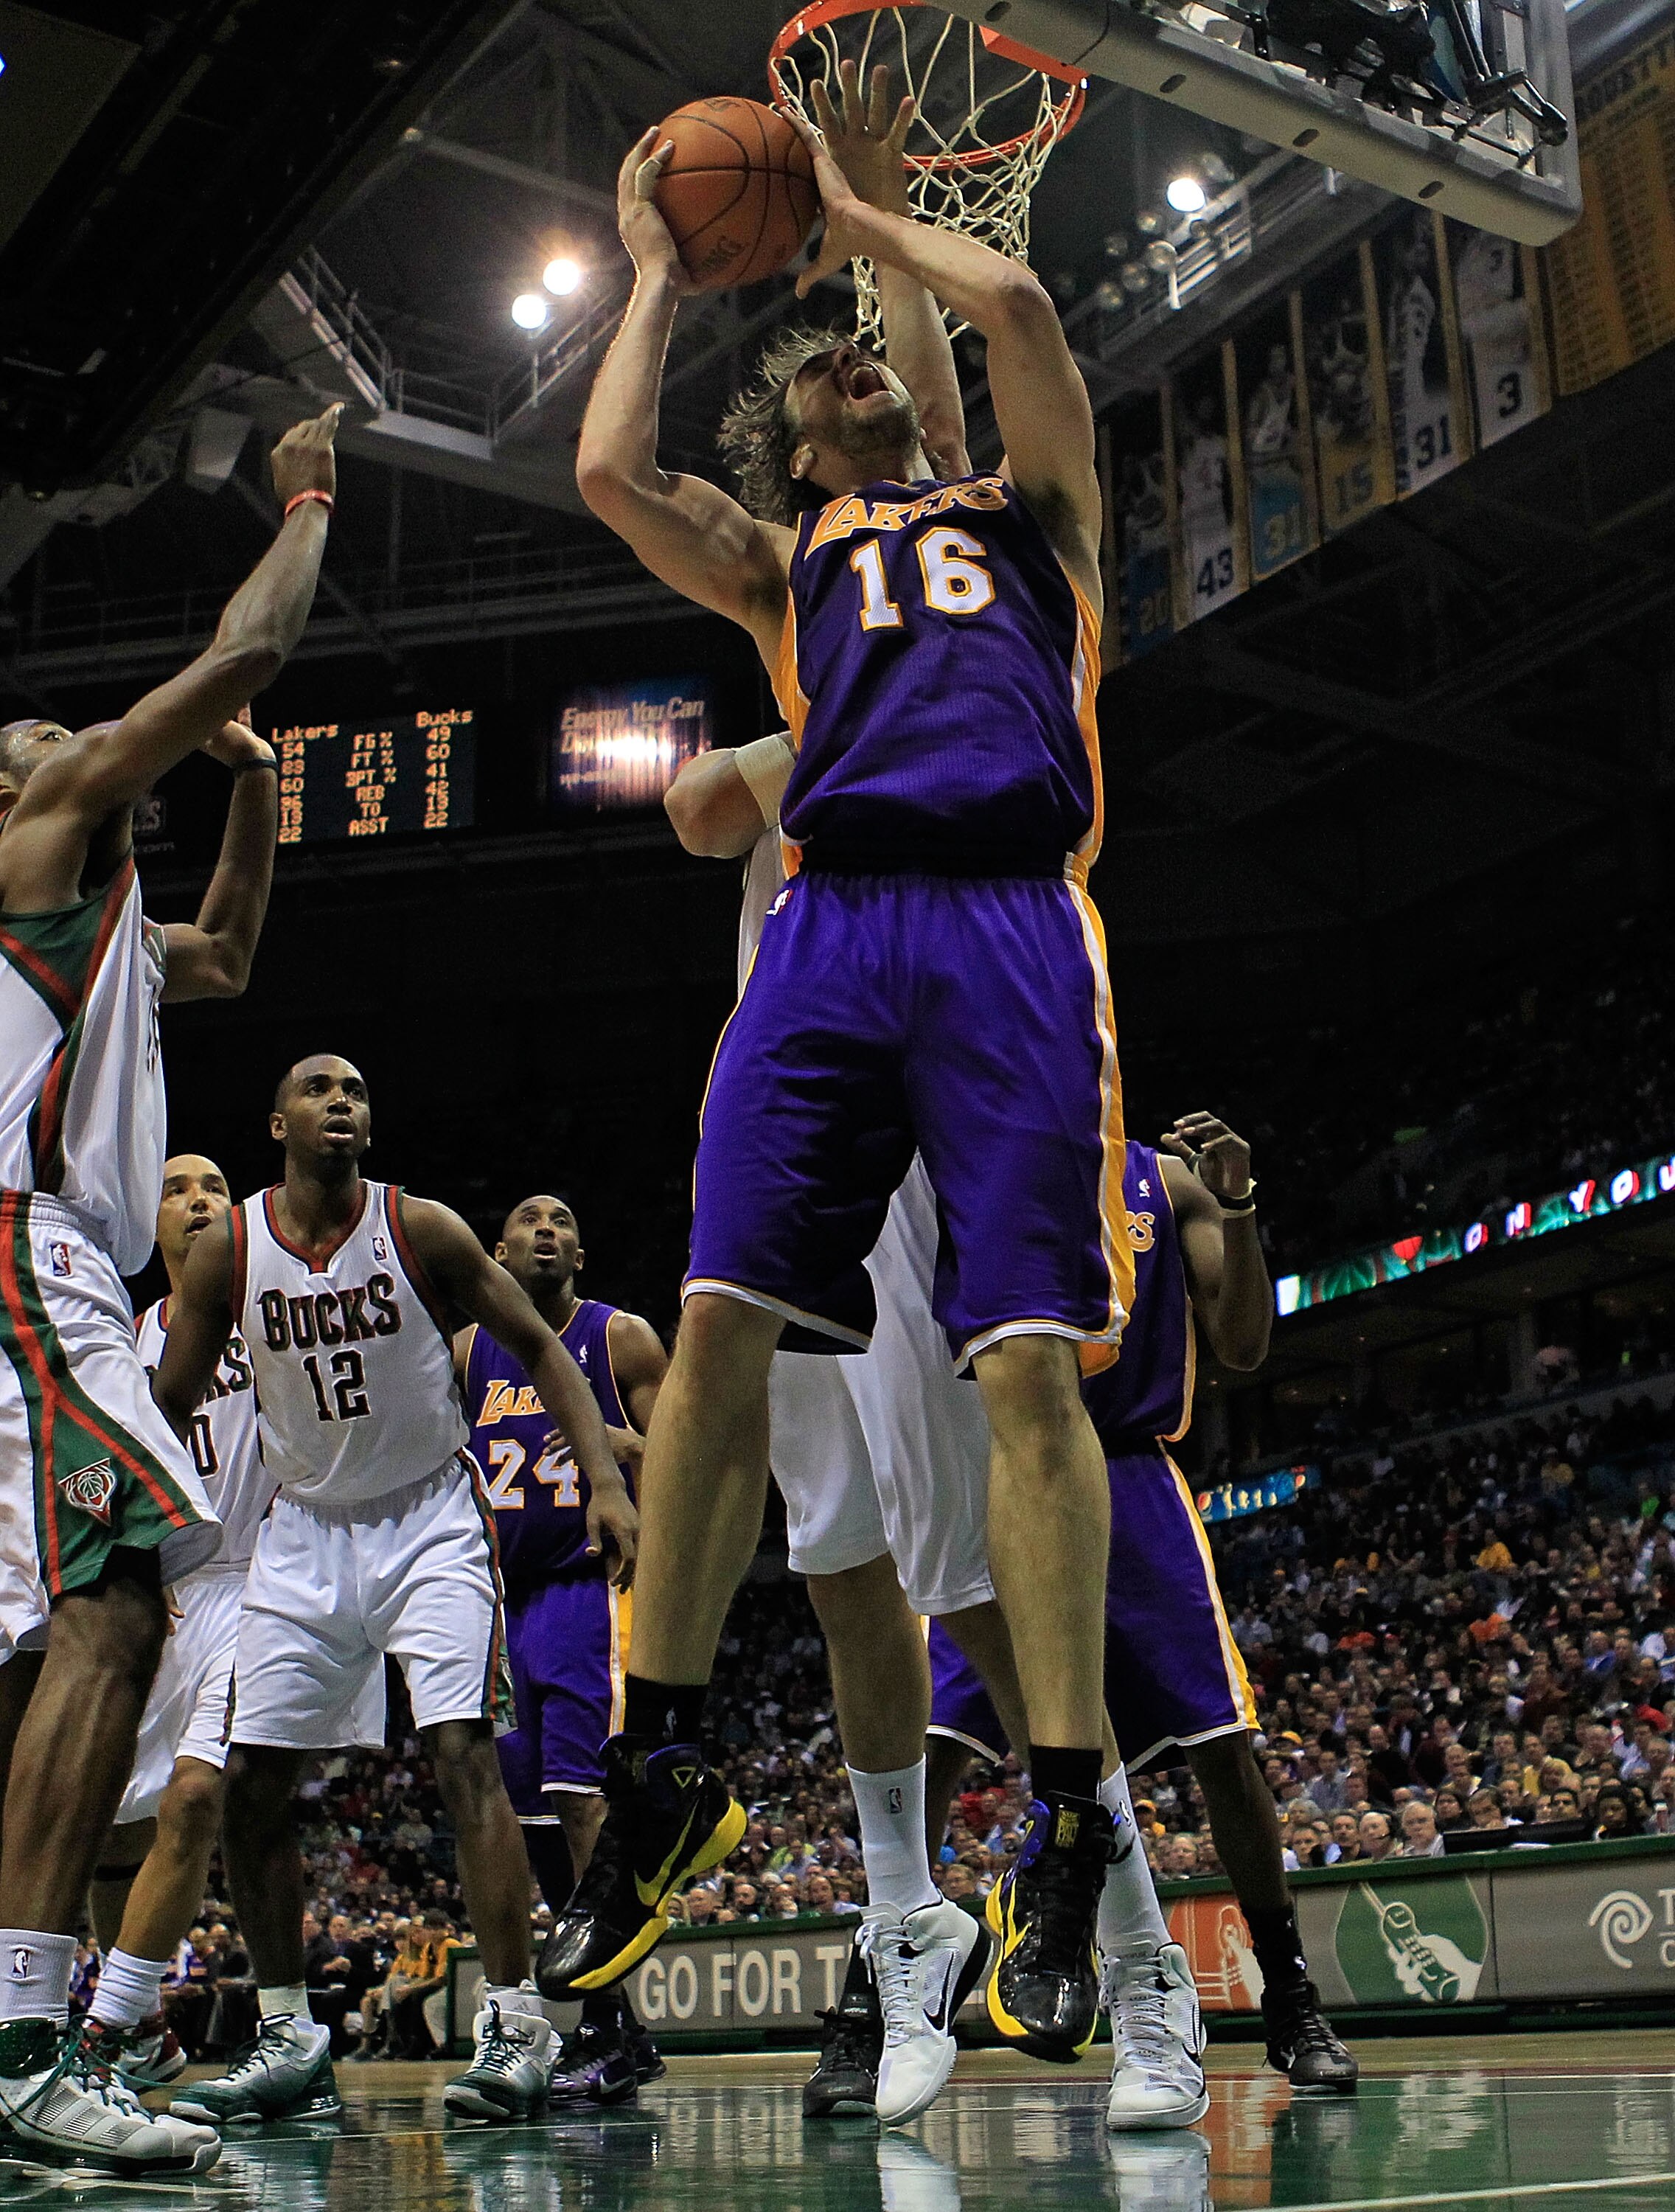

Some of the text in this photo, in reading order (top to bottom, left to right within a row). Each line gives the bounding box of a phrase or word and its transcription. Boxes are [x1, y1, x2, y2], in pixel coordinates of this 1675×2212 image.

[1497, 372, 1522, 418] 3
[1416, 415, 1453, 468] 31
[849, 526, 996, 632] 16
[1197, 548, 1234, 598] 43
[417, 709, 473, 727] Bucks
[272, 725, 338, 743] Lakers
[354, 732, 392, 750] FG %
[427, 726, 450, 741] 49
[282, 742, 304, 758] 54
[426, 744, 450, 759] 60
[351, 751, 393, 768] FT %
[346, 768, 396, 786] 3PT %
[426, 762, 447, 777] 41
[281, 777, 304, 793] 60
[355, 785, 385, 801] REB
[425, 780, 448, 795] 42
[360, 802, 380, 816] TO
[349, 818, 389, 835] ASST
[425, 812, 448, 828] 22
[279, 827, 302, 843] 22
[257, 1272, 403, 1352] BUCKS
[302, 1348, 372, 1422] 12
[476, 1380, 546, 1427] LAK
[489, 1439, 580, 1510] 24
[639, 1944, 849, 2020] GO FOR T
